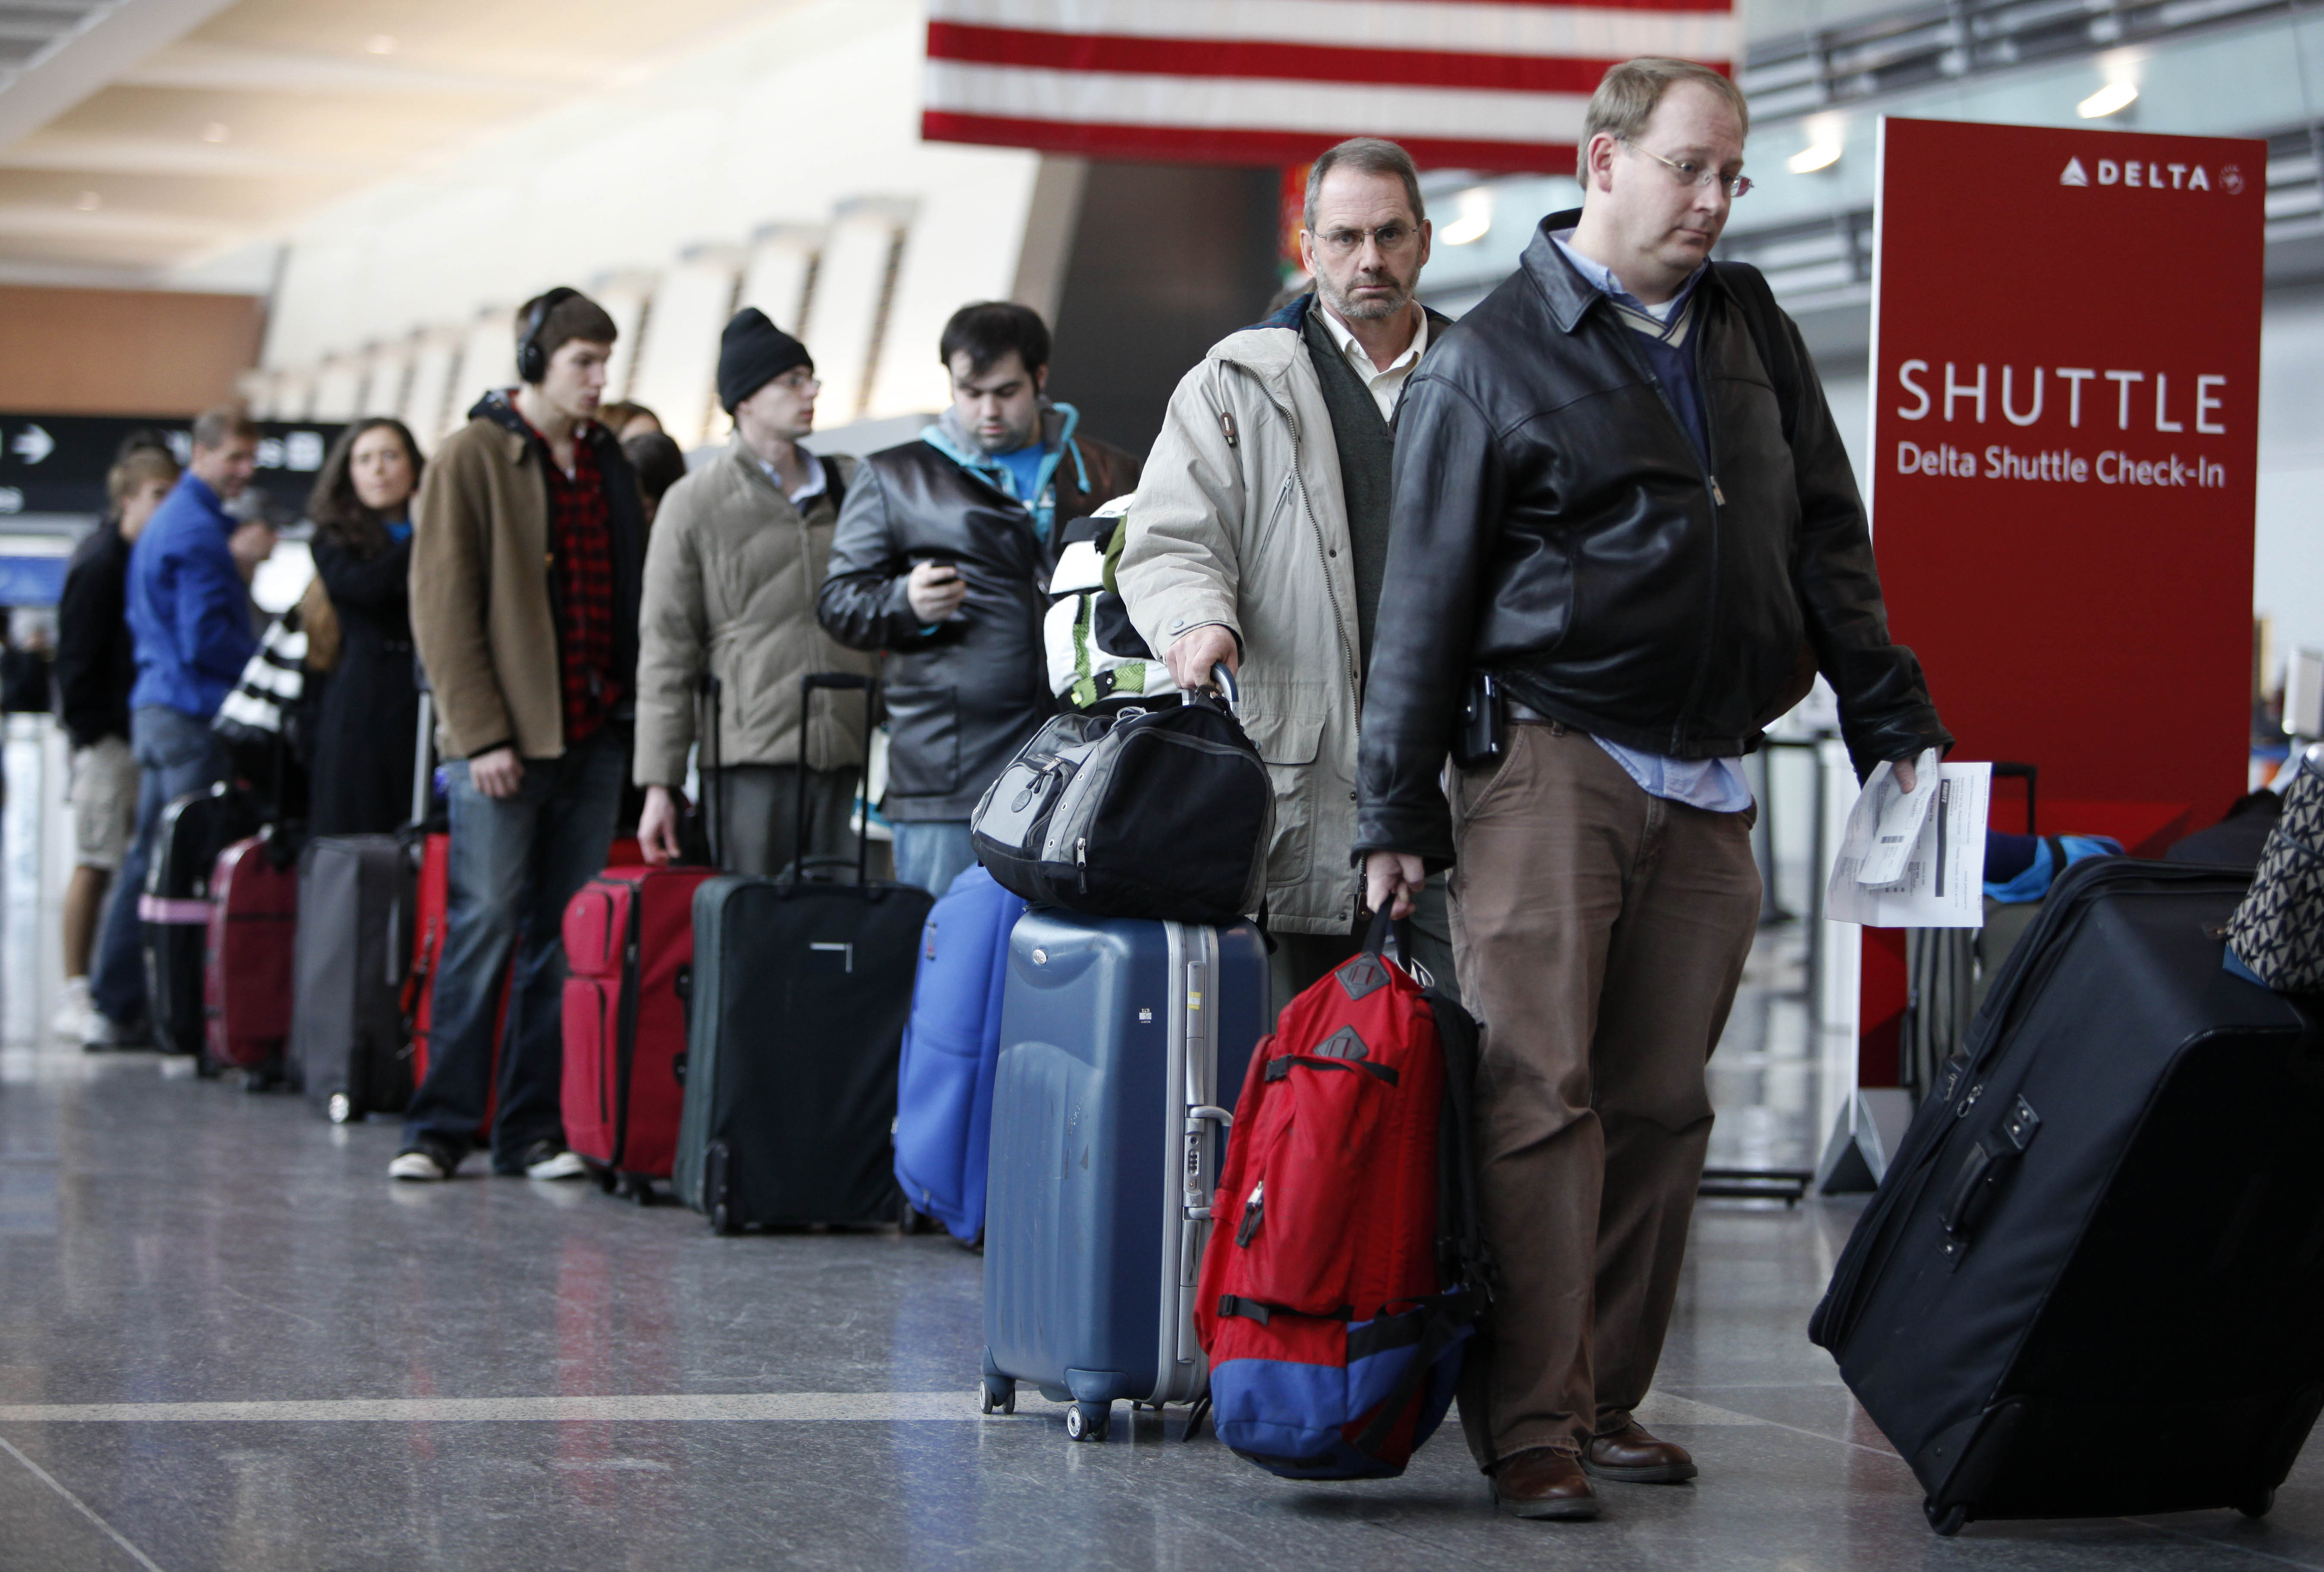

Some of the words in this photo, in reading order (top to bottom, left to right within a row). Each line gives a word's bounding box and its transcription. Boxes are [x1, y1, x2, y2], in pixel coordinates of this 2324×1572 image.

[2098, 160, 2209, 191] DELTA
[1898, 359, 2225, 434] SHUTTLE
[1898, 441, 1976, 477] Delta
[1985, 446, 2088, 482] Shuttle
[2096, 451, 2224, 486] Check-In
